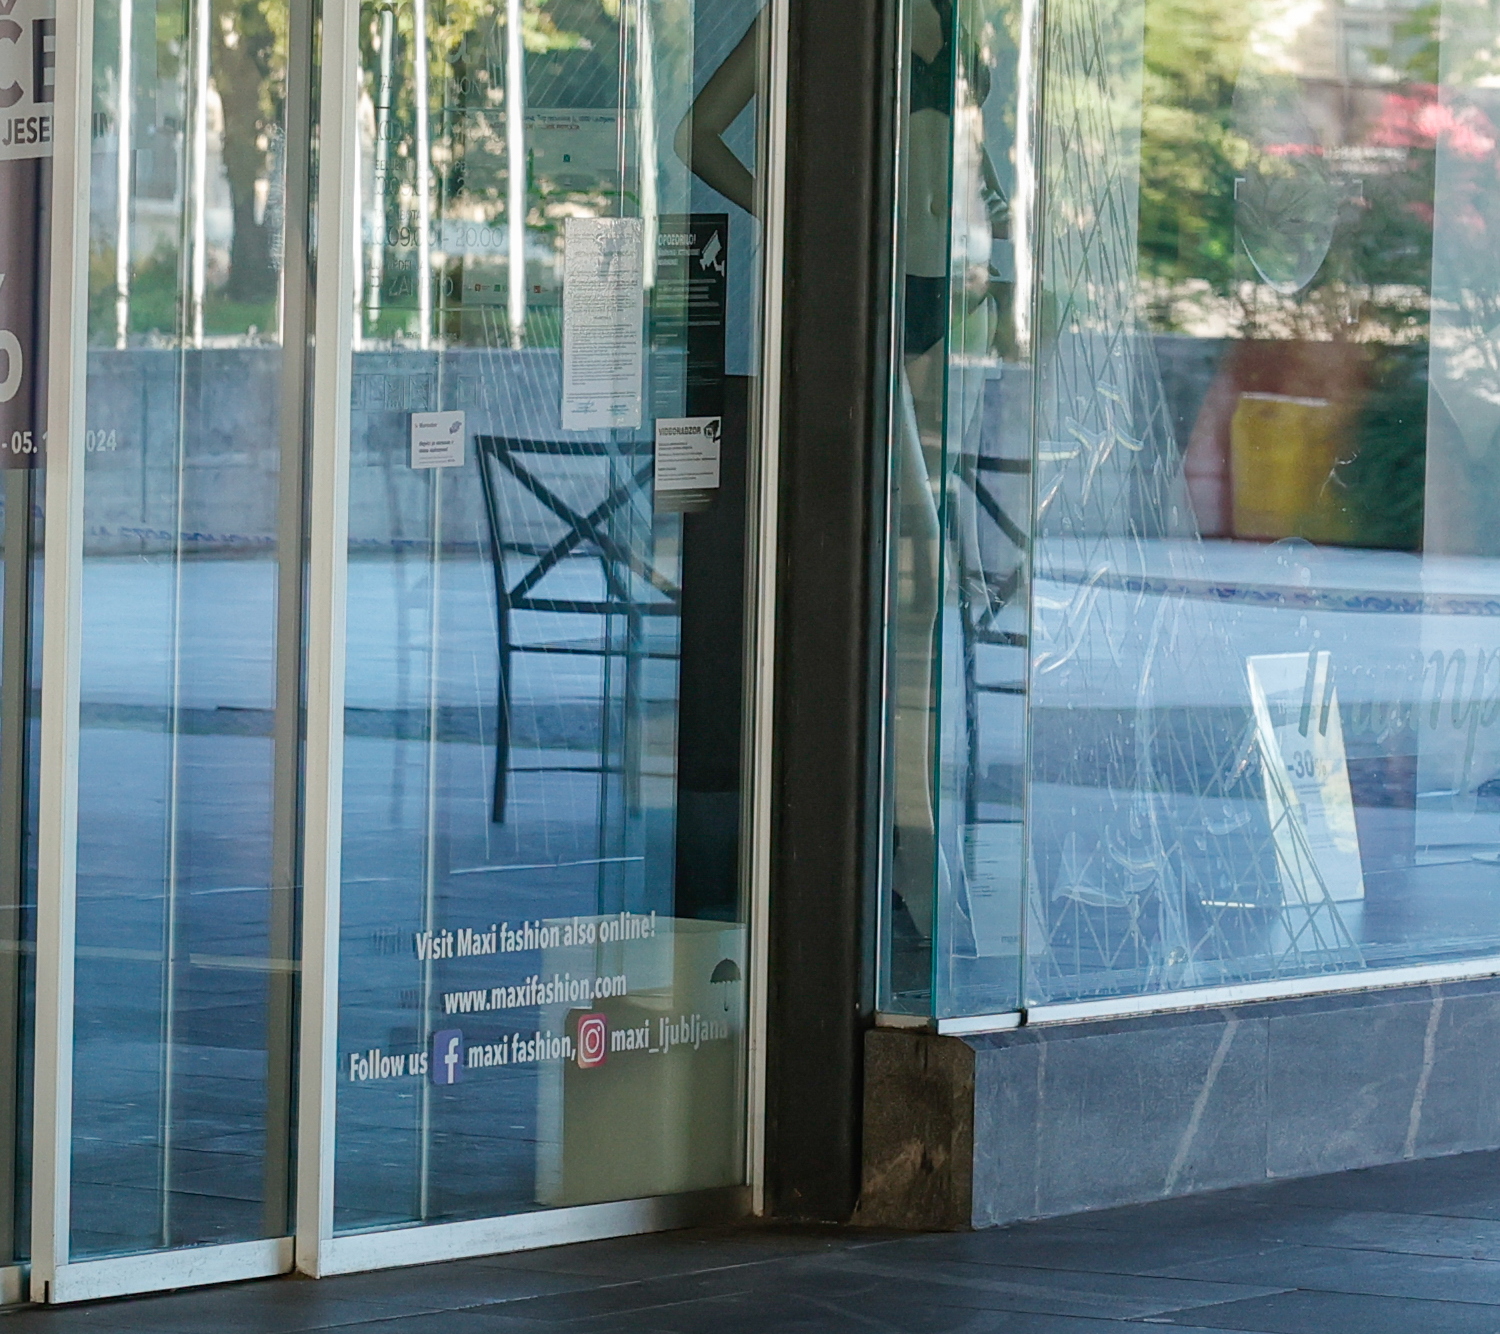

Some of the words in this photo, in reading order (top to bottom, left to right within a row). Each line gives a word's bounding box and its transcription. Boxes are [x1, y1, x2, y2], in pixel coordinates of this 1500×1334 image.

[2, 116, 54, 146] JESE
[11, 431, 38, 454] 05.
[416, 930, 454, 962] Visit
[457, 926, 497, 958] Maxi
[500, 921, 560, 954] fashion
[563, 917, 596, 948] also
[599, 910, 656, 944] online!
[444, 973, 628, 1015] www.maxifashion.com
[350, 1052, 405, 1082] Follow
[408, 1054, 428, 1077] us
[468, 1036, 508, 1068] maxi
[511, 1033, 577, 1066] fashion,
